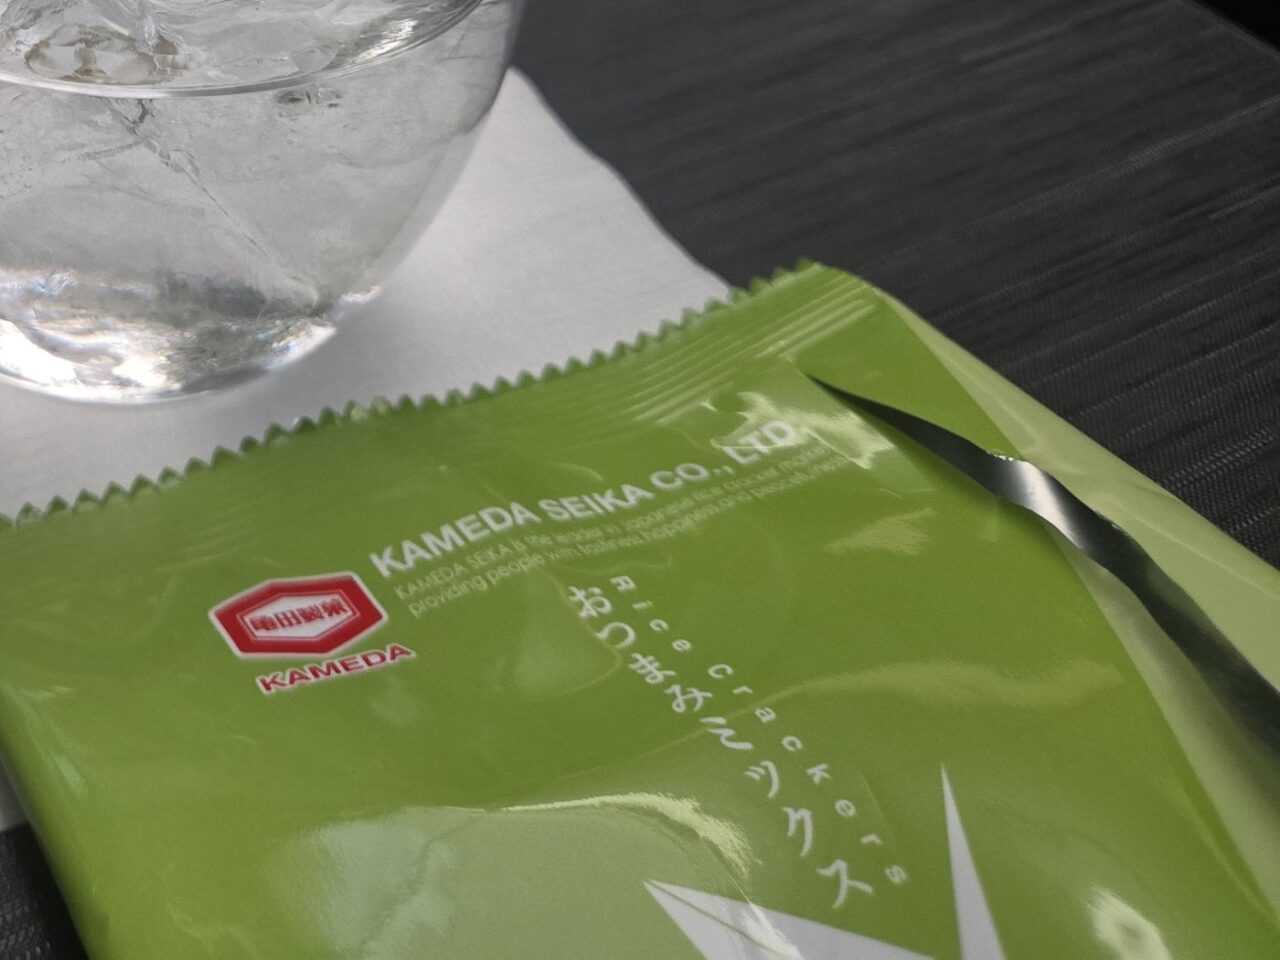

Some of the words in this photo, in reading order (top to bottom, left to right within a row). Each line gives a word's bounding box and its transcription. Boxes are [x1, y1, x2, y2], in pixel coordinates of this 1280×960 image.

[369, 501, 541, 577] KAMEDA
[538, 484, 655, 521] SEIKA
[394, 562, 467, 600] KAMEDA
[466, 543, 513, 570] SEIKA
[408, 575, 488, 618] providing
[486, 552, 545, 586] people
[610, 575, 693, 652] Rice
[258, 643, 415, 693] KAMEDA
[568, 586, 874, 909] おつまみミックス
